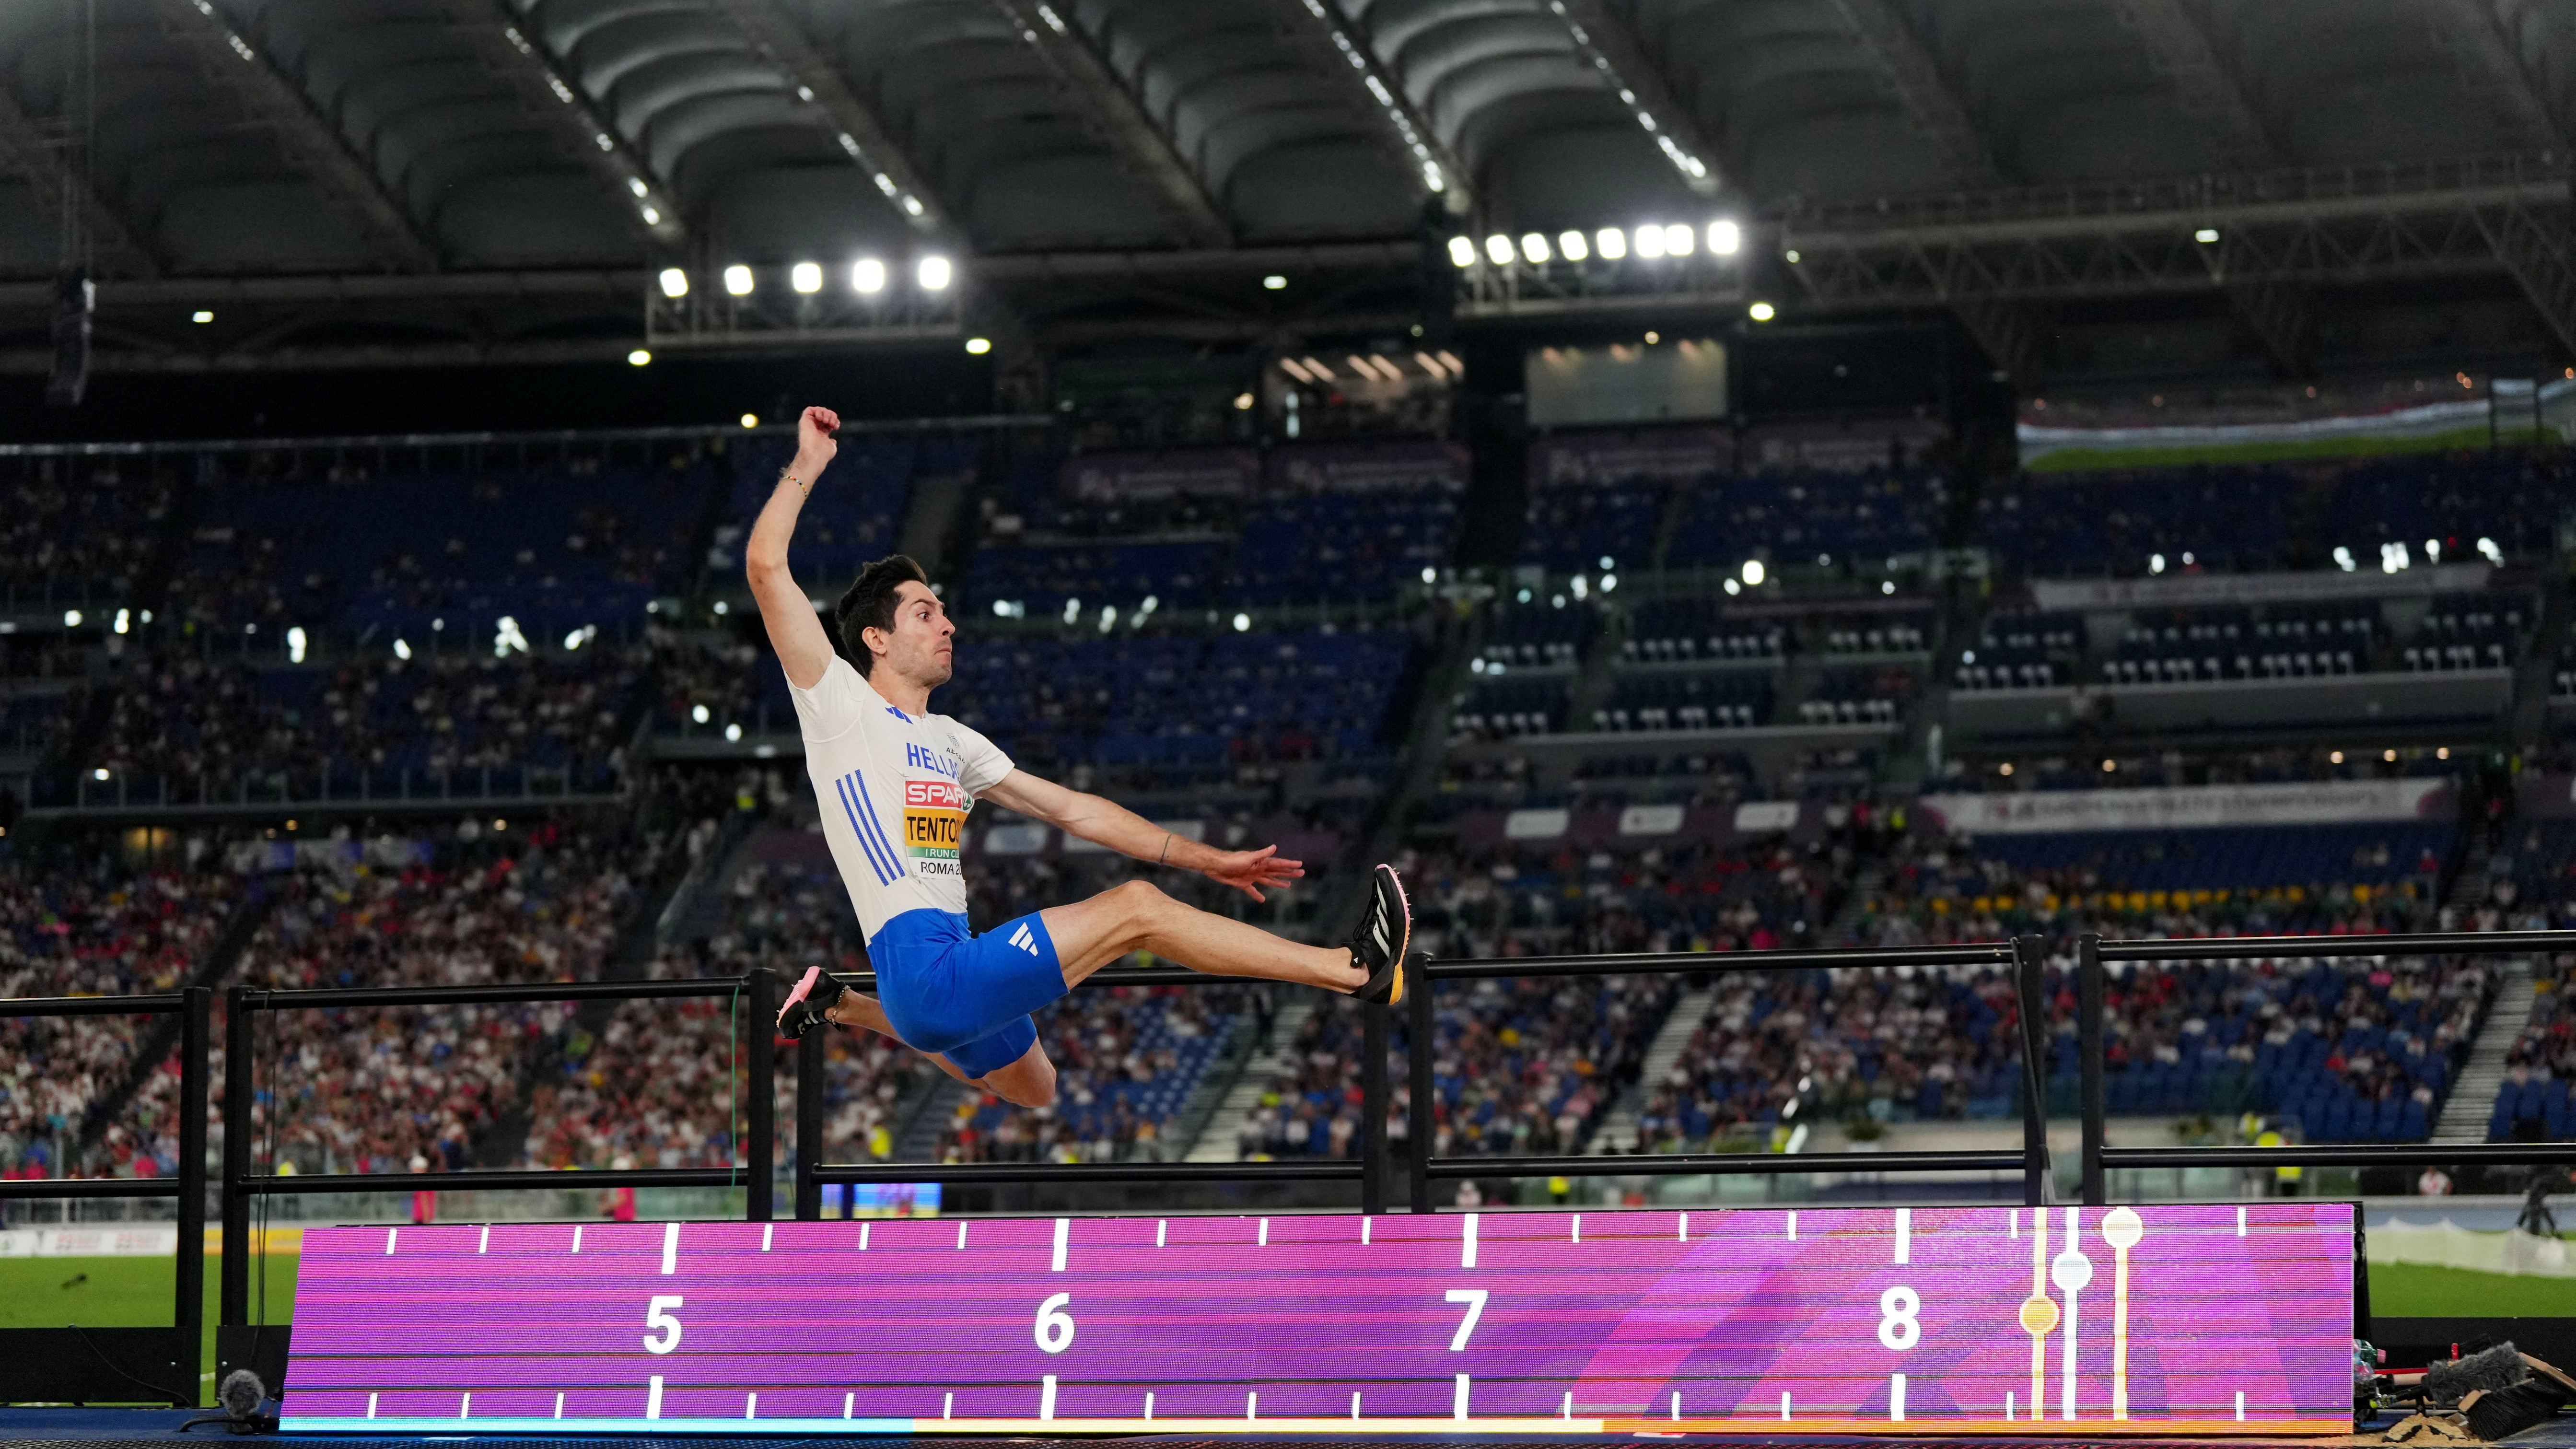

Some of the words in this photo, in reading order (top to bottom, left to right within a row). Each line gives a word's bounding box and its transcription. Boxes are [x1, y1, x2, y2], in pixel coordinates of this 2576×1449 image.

[906, 742, 960, 783] HELLA
[908, 784, 964, 805] SPAR
[921, 862, 954, 875] ROMA
[925, 848, 928, 857] I
[930, 848, 949, 858] RUN
[951, 850, 959, 858] CL
[643, 1296, 684, 1354] 5
[1034, 1293, 1075, 1353] 6
[1445, 1290, 1488, 1351] 7
[1878, 1286, 1921, 1350] 8
